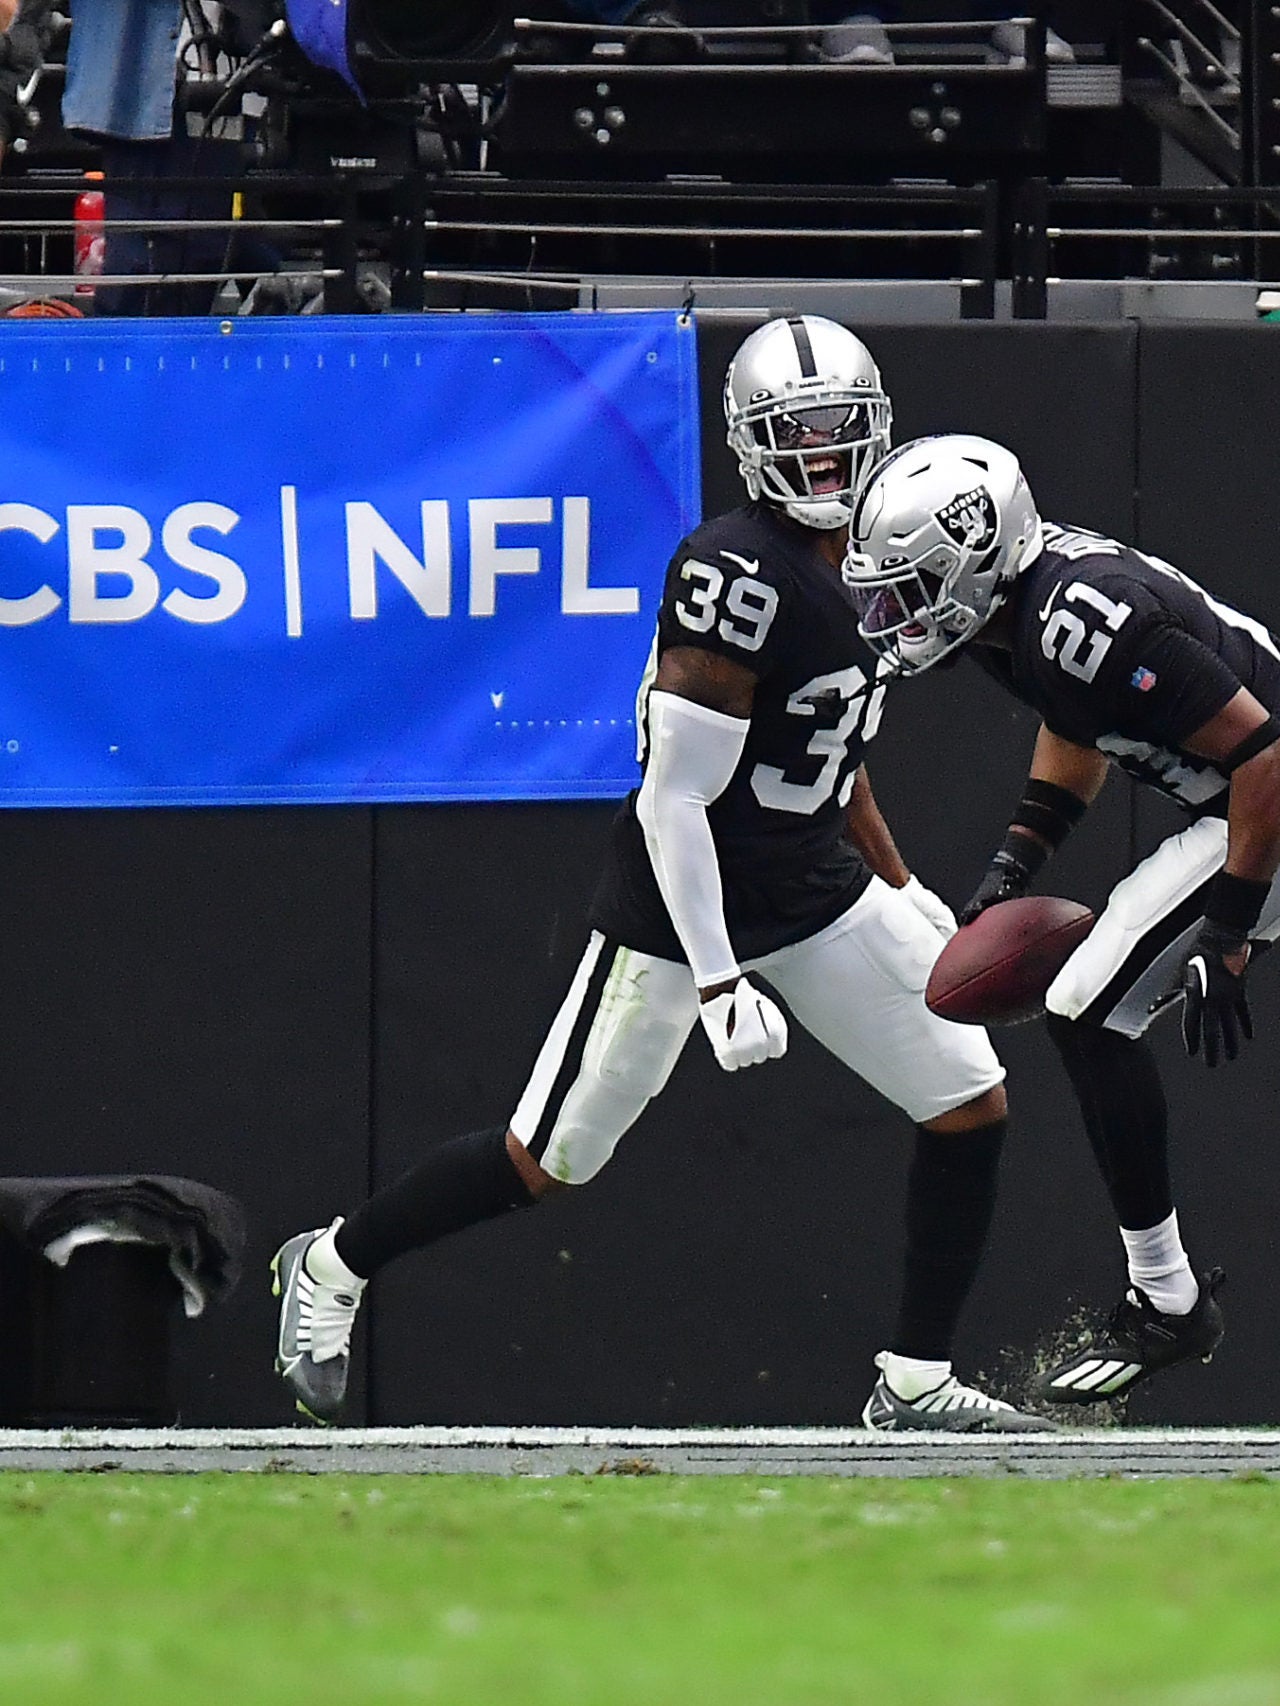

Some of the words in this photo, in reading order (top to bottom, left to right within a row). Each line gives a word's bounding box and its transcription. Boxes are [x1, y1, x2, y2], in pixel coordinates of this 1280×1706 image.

[0, 501, 248, 627] CBS
[345, 496, 641, 620] NFL
[675, 558, 780, 653] 39
[1041, 581, 1134, 685] 21
